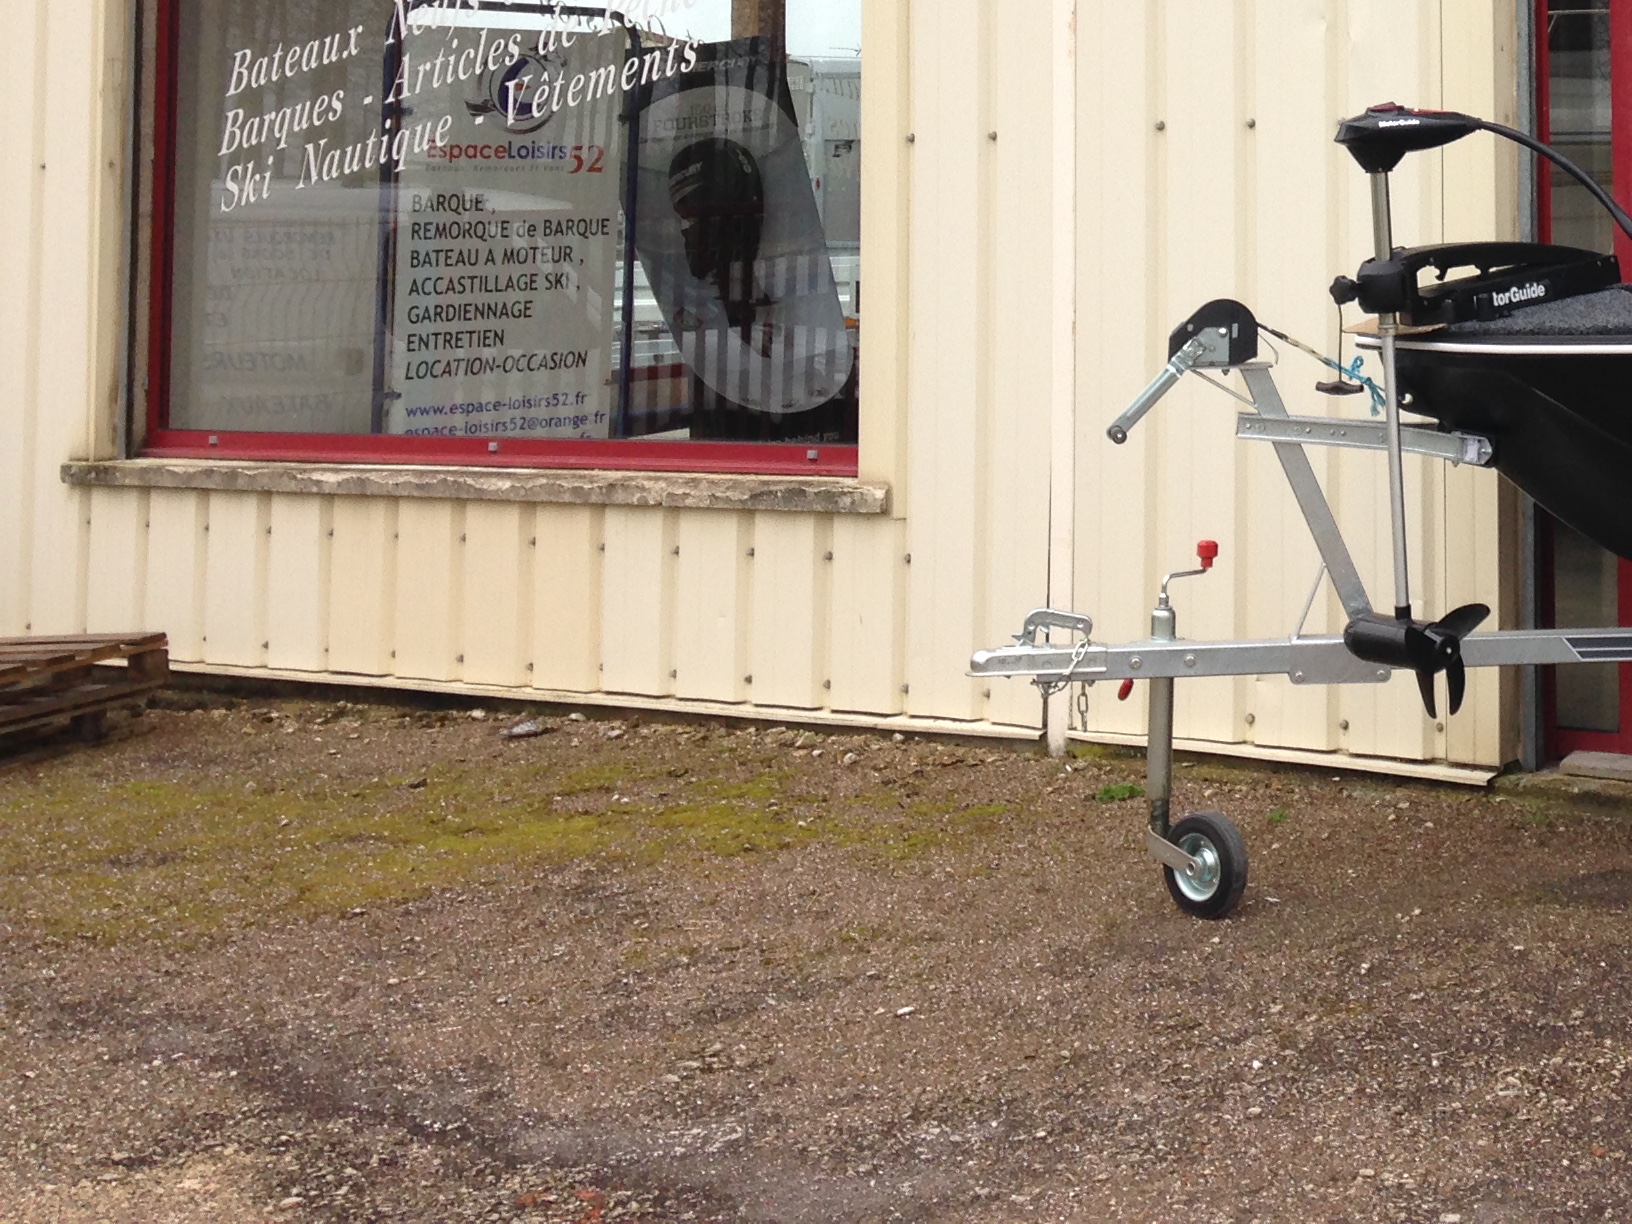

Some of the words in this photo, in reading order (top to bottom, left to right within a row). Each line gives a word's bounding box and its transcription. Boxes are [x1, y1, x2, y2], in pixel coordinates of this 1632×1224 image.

[226, 25, 363, 97] Bateaux
[218, 89, 344, 157] Barques
[384, 27, 522, 105] Articles
[220, 155, 274, 213] Ski
[295, 115, 452, 190] Nautique
[505, 38, 699, 127] Vêtements
[412, 193, 485, 215] BARQUE
[411, 220, 510, 242] REMORQUE
[516, 219, 537, 237] de
[543, 218, 610, 239] BARQUE
[410, 249, 479, 268] BATEAU
[484, 248, 498, 266] A
[502, 246, 573, 266] MOTEUR
[408, 273, 539, 296] ACCASTILLAGE
[544, 272, 570, 290] SKI
[1492, 282, 1546, 307] torGuide
[407, 300, 534, 324] GARDIENNAGE
[406, 329, 505, 352] ENTRETIEN
[404, 350, 589, 380] LOCATION-OCCASION
[405, 391, 588, 418] www.espace-loisirs52.fr
